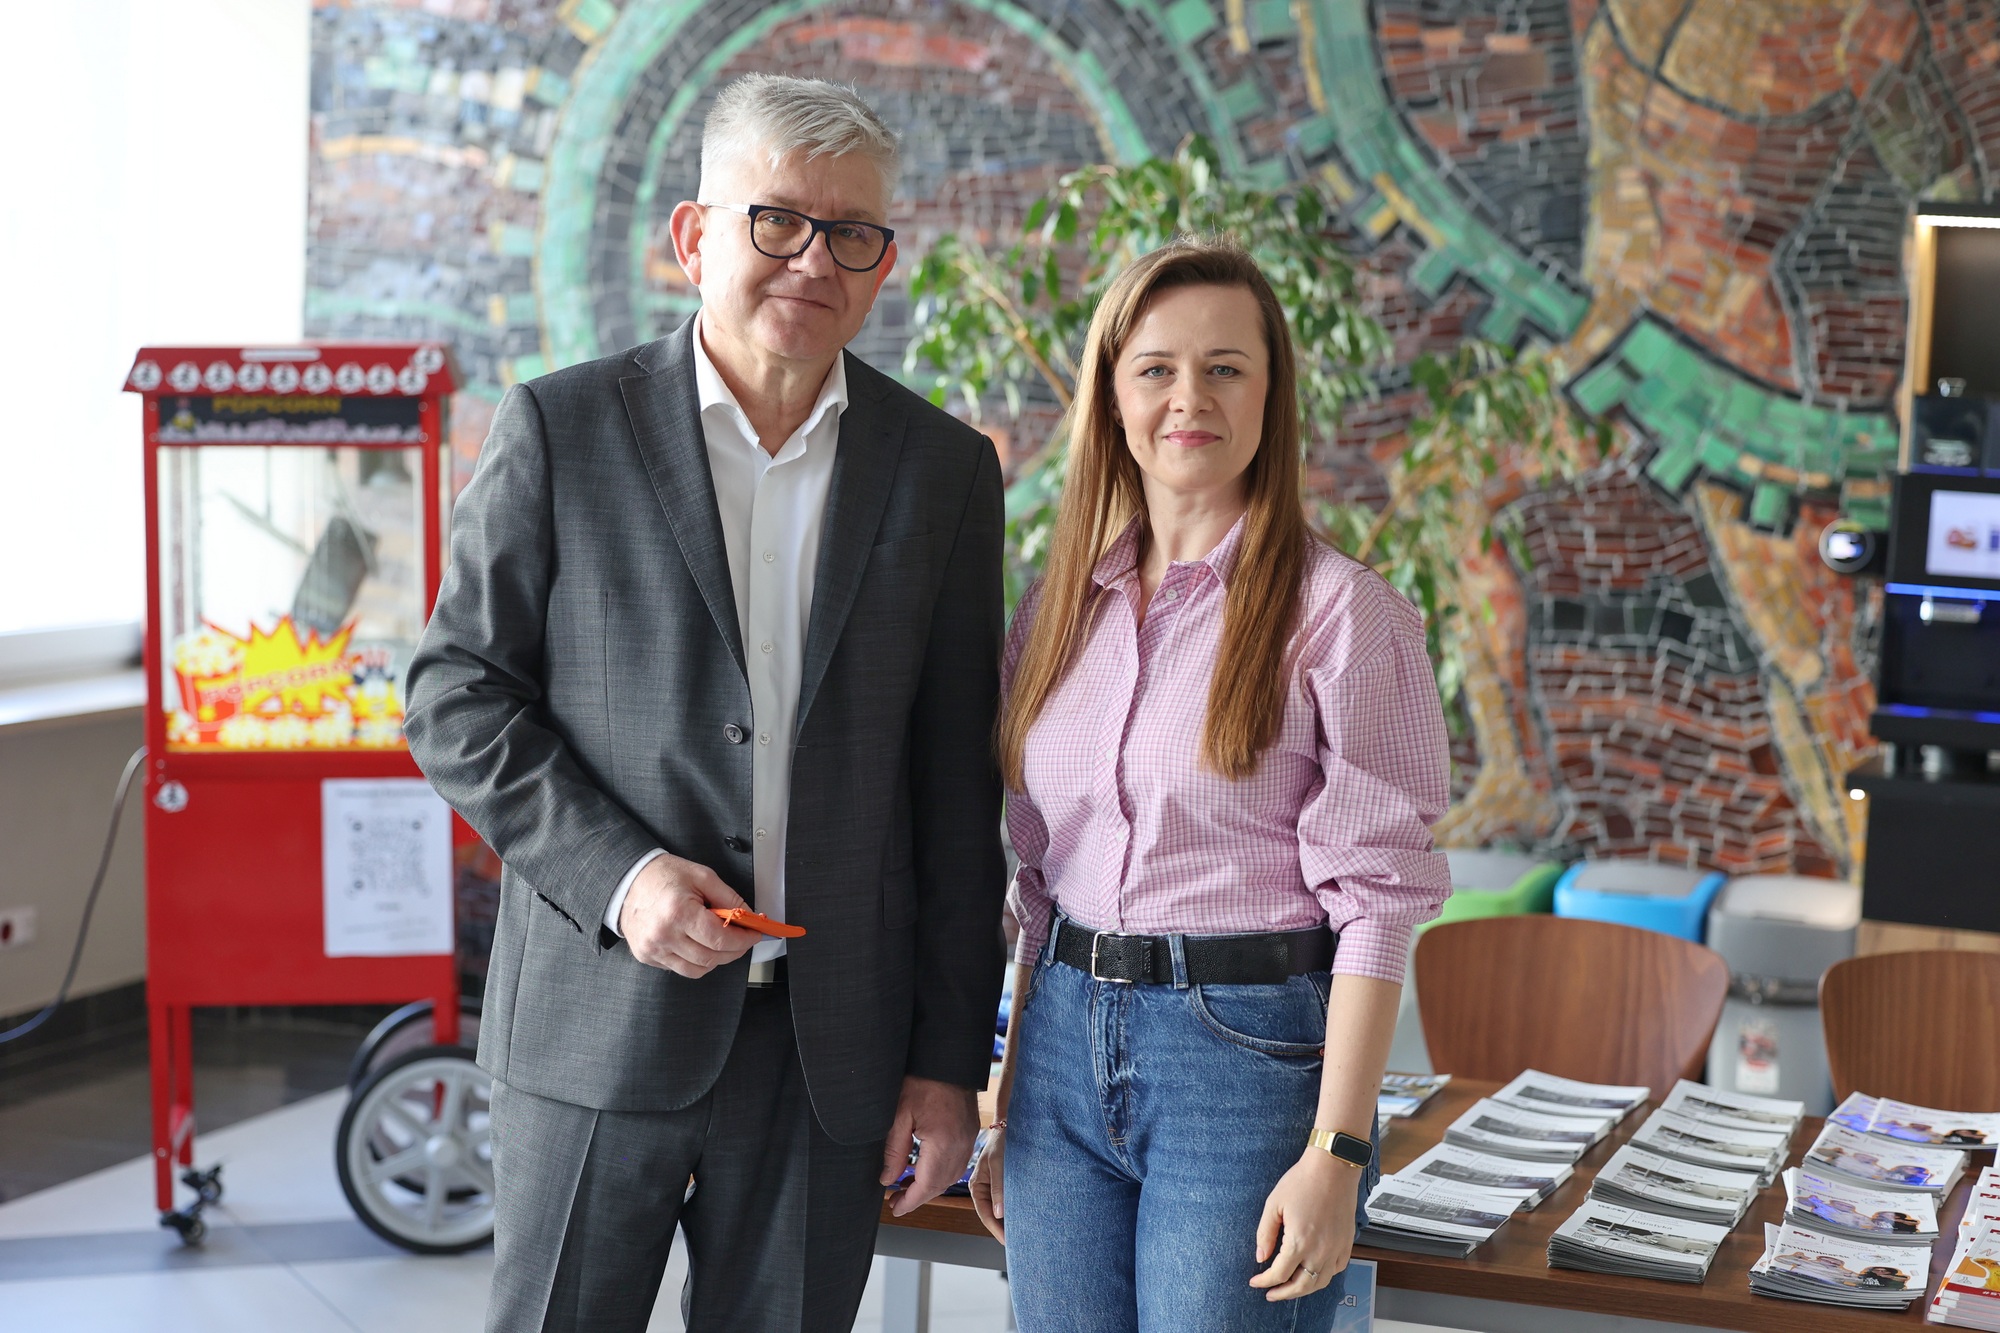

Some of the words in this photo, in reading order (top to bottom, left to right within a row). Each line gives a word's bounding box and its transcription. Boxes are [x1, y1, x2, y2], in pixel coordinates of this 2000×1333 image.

[204, 657, 351, 700] POPCORN
[1631, 1218, 1674, 1231] logistyka
[1338, 1294, 1357, 1307] CI
